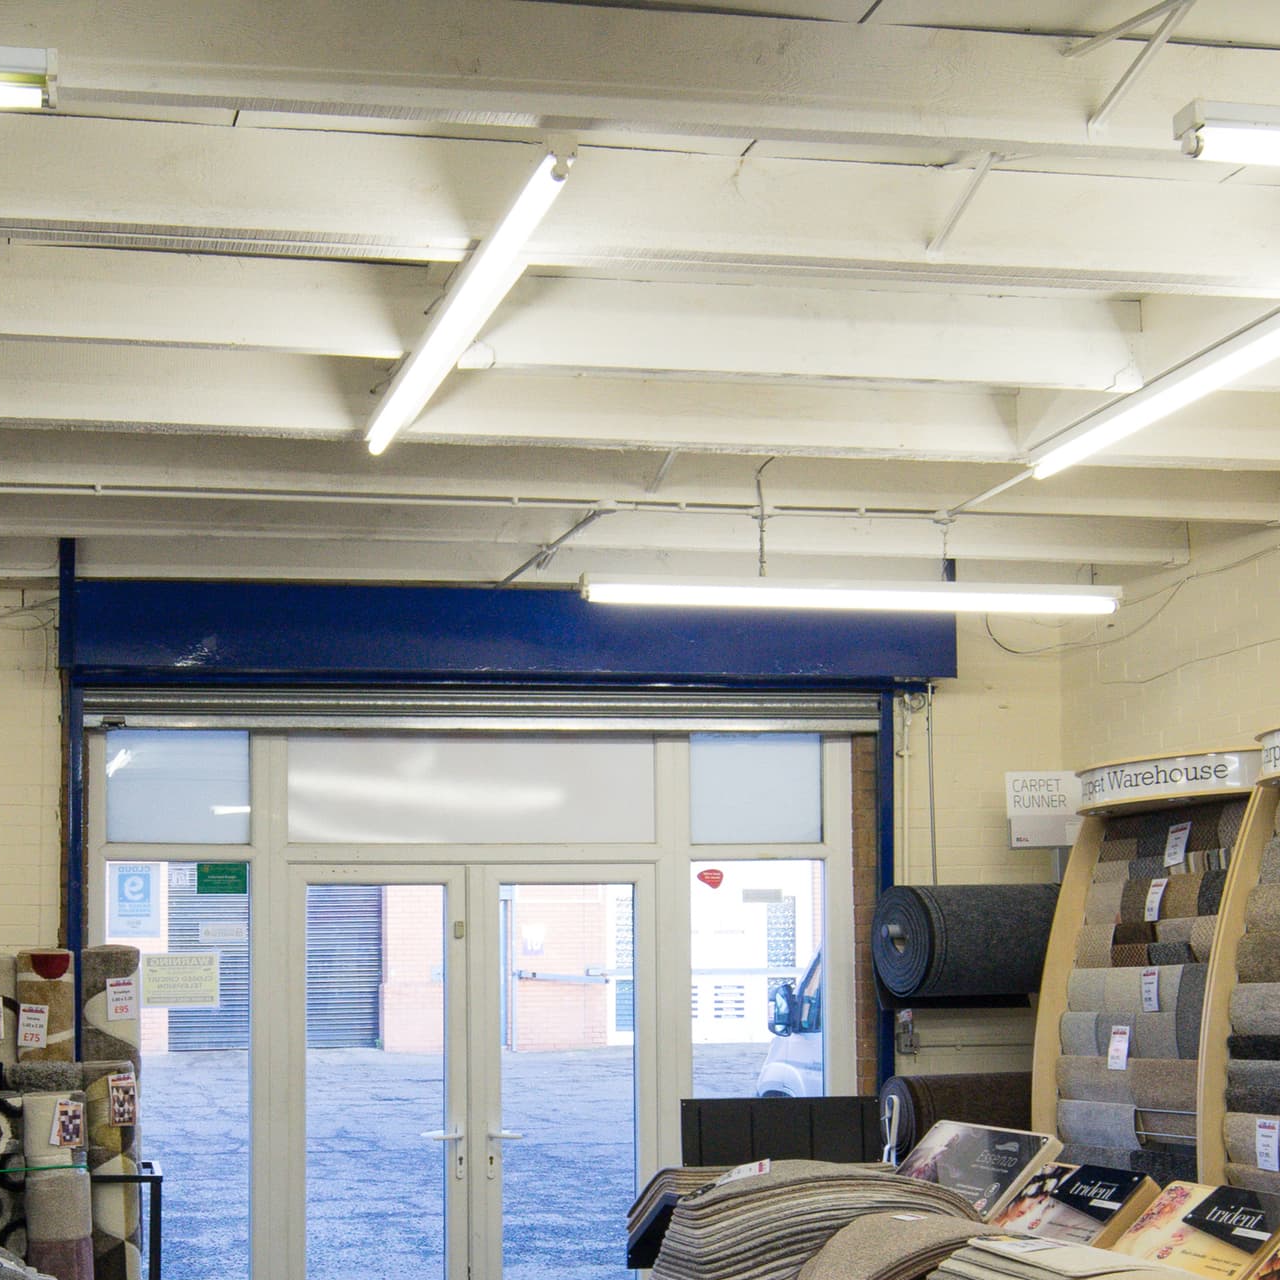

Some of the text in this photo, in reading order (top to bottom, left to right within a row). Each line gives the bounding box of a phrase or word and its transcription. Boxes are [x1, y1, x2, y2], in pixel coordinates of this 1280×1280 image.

[1106, 763, 1229, 791] Warehouse
[1012, 778, 1061, 793] CARPET
[1013, 794, 1067, 809] RUNNER
[114, 1005, 129, 1014] £95
[23, 1033, 40, 1043] £75
[1069, 1180, 1118, 1201] trident
[1205, 1205, 1264, 1229] trident
